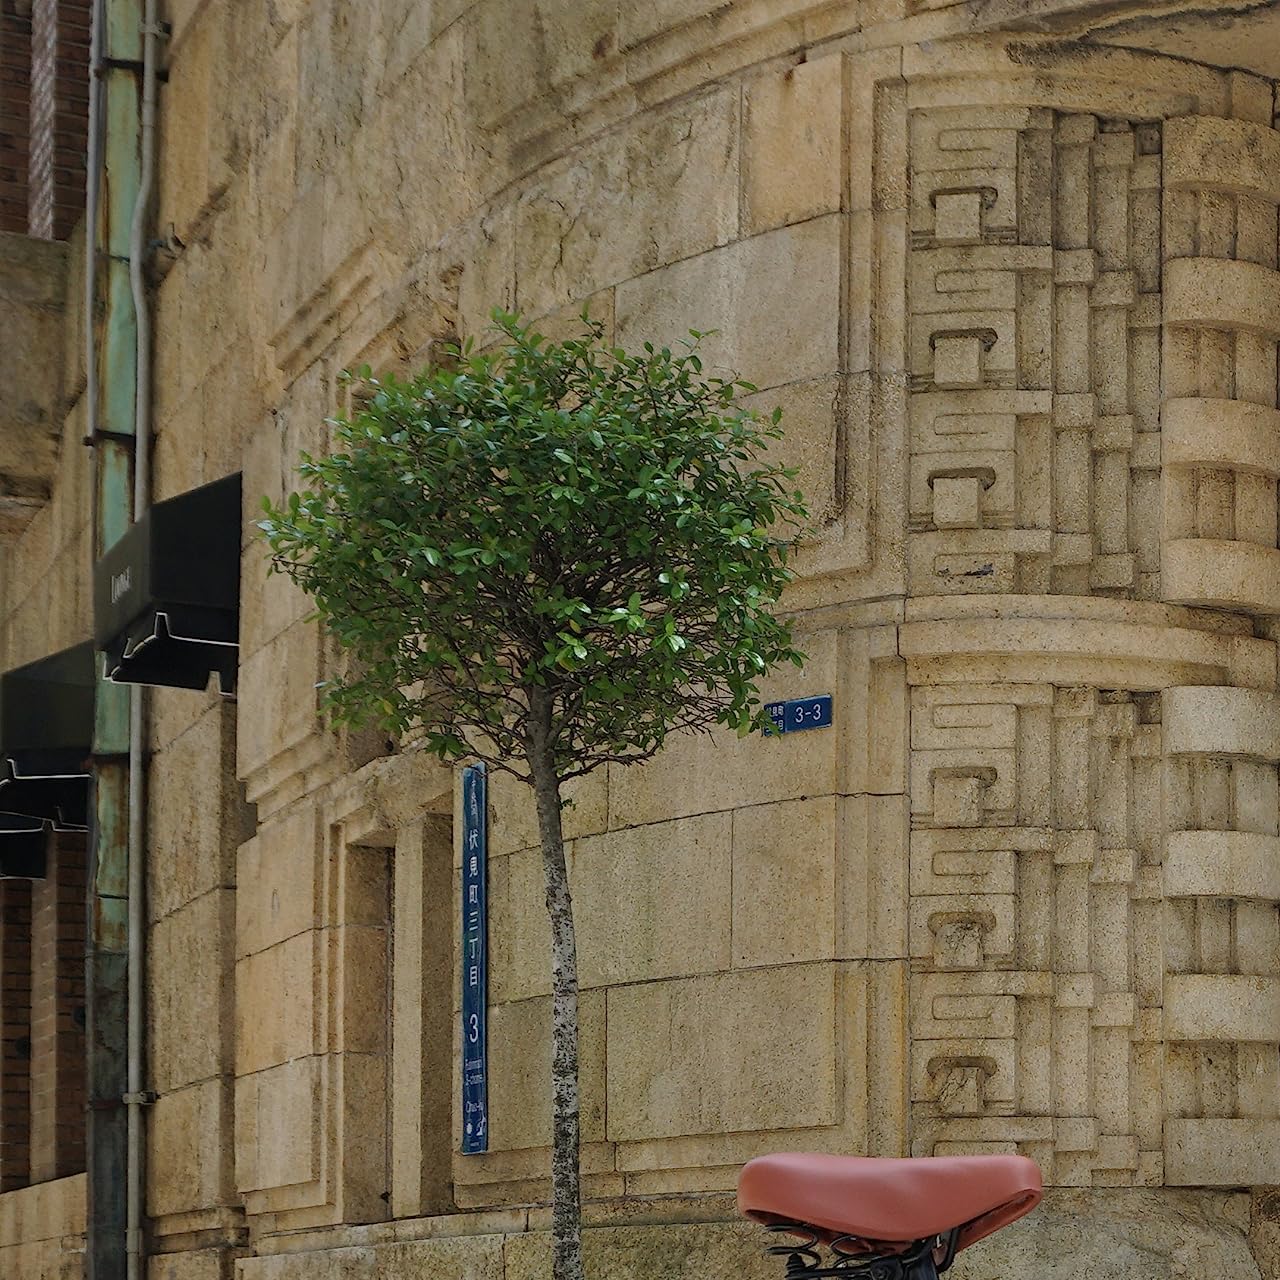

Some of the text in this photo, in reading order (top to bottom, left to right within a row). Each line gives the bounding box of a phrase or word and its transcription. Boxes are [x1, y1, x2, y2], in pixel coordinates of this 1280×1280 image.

[795, 703, 821, 723] 3-3
[468, 828, 479, 987] 伏見町三丁目
[468, 1013, 479, 1044] 3
